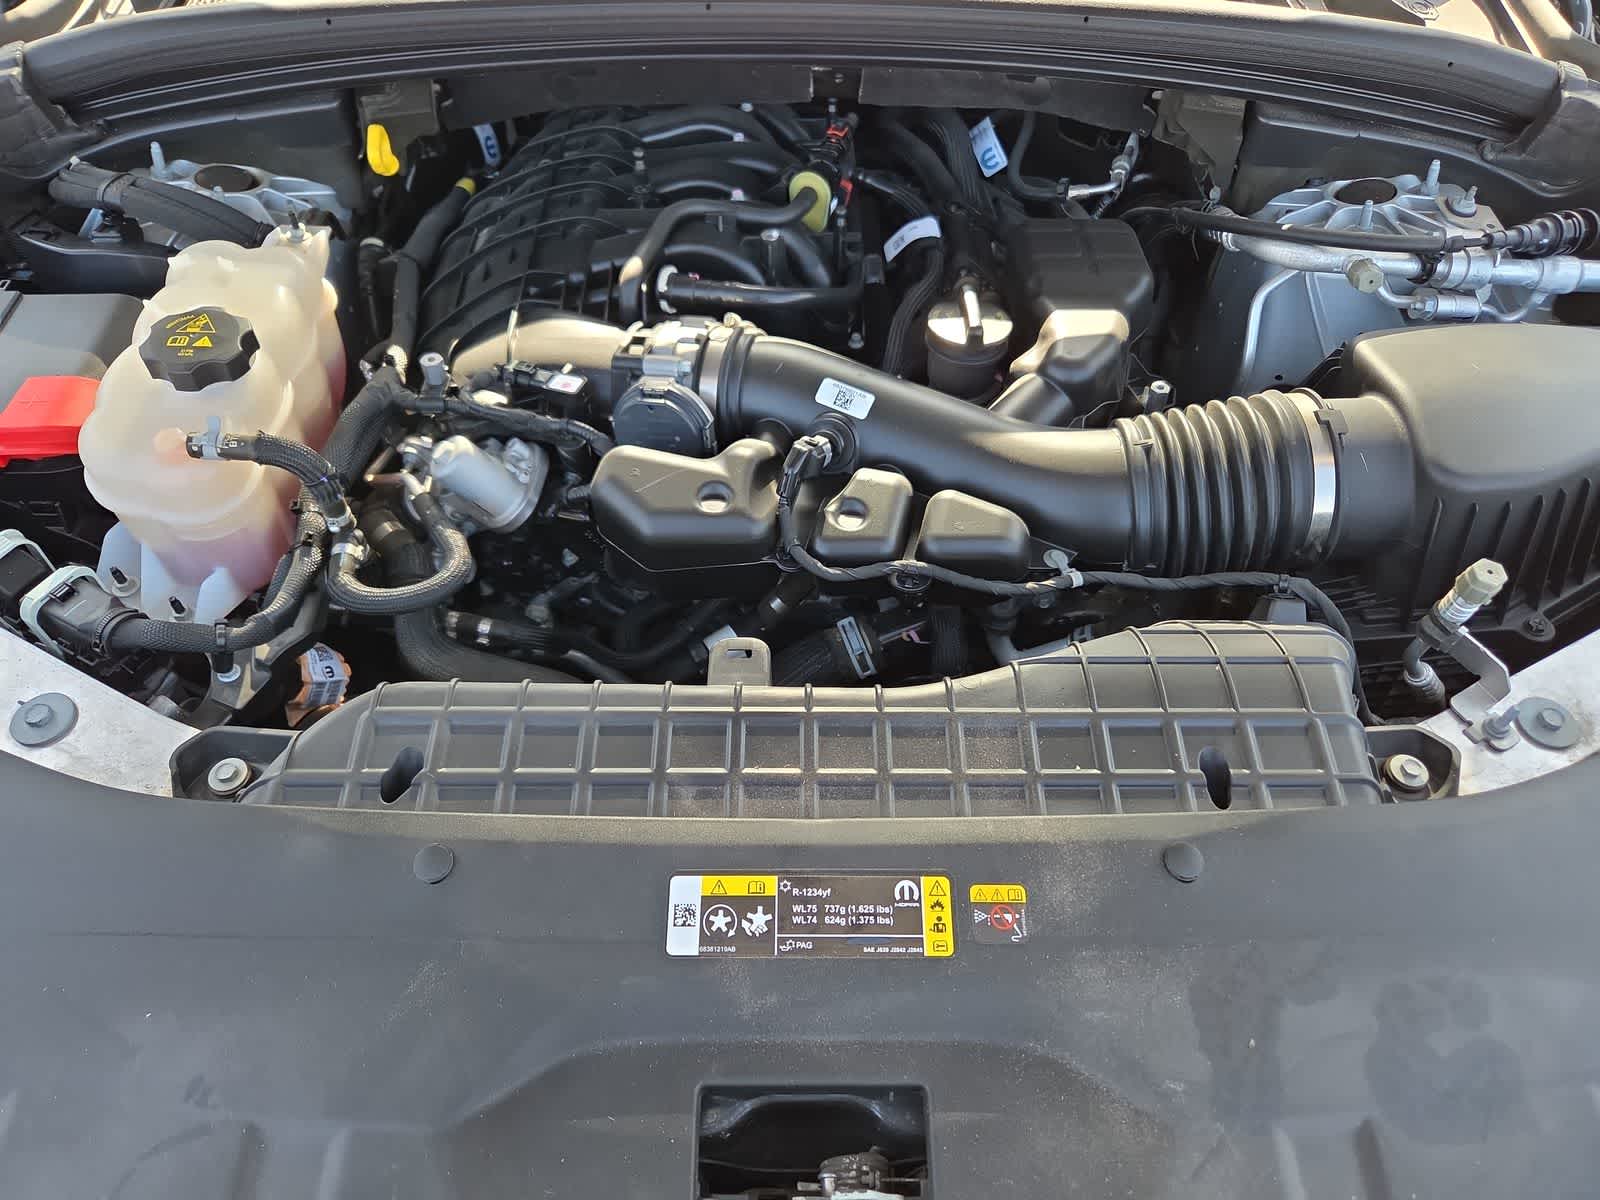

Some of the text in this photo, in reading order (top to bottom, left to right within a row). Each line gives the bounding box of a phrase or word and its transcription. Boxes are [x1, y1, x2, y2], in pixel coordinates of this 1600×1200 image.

[792, 887, 832, 899] R-1234yf
[792, 904, 894, 915] WL75 737g (1.625 lbs)
[792, 915, 894, 926] WL74 624g (1.375 lbs)
[796, 941, 813, 950] PAG
